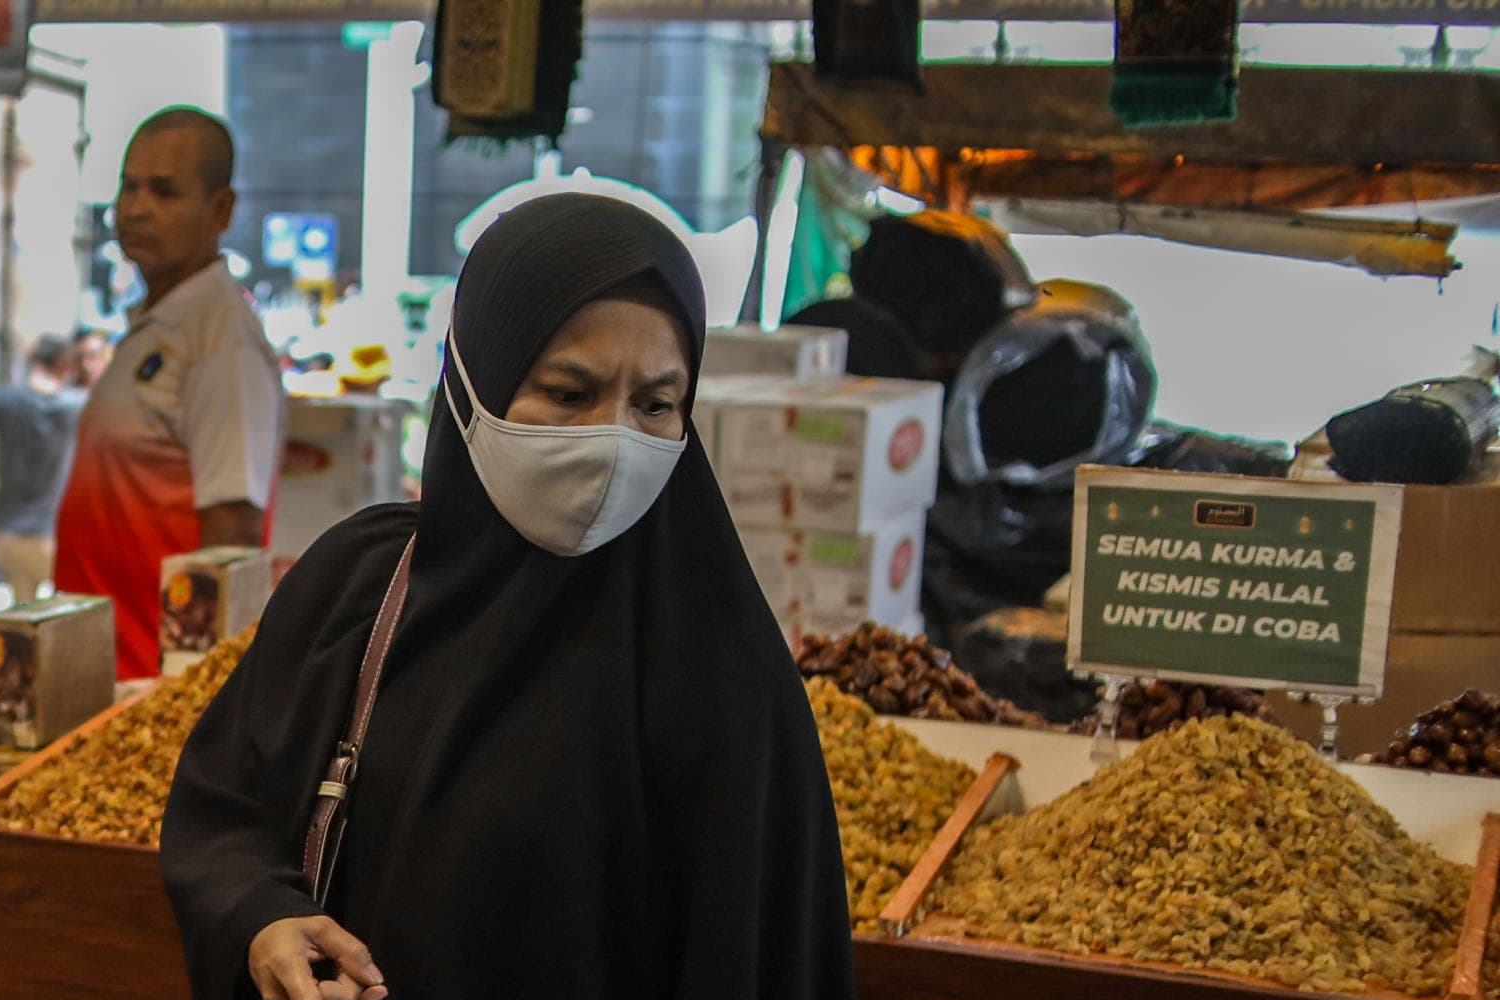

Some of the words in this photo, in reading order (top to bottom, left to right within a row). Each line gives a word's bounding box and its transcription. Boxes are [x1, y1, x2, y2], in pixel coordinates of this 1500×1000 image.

[1097, 534, 1203, 561] SEMUA
[1211, 542, 1325, 570] KURMA
[1333, 551, 1356, 571] &
[1117, 570, 1221, 598] KISMIS
[1227, 579, 1329, 606] HALAL
[1102, 603, 1207, 632] UNTUK
[1211, 613, 1247, 635] DI
[1253, 616, 1341, 643] COBA
